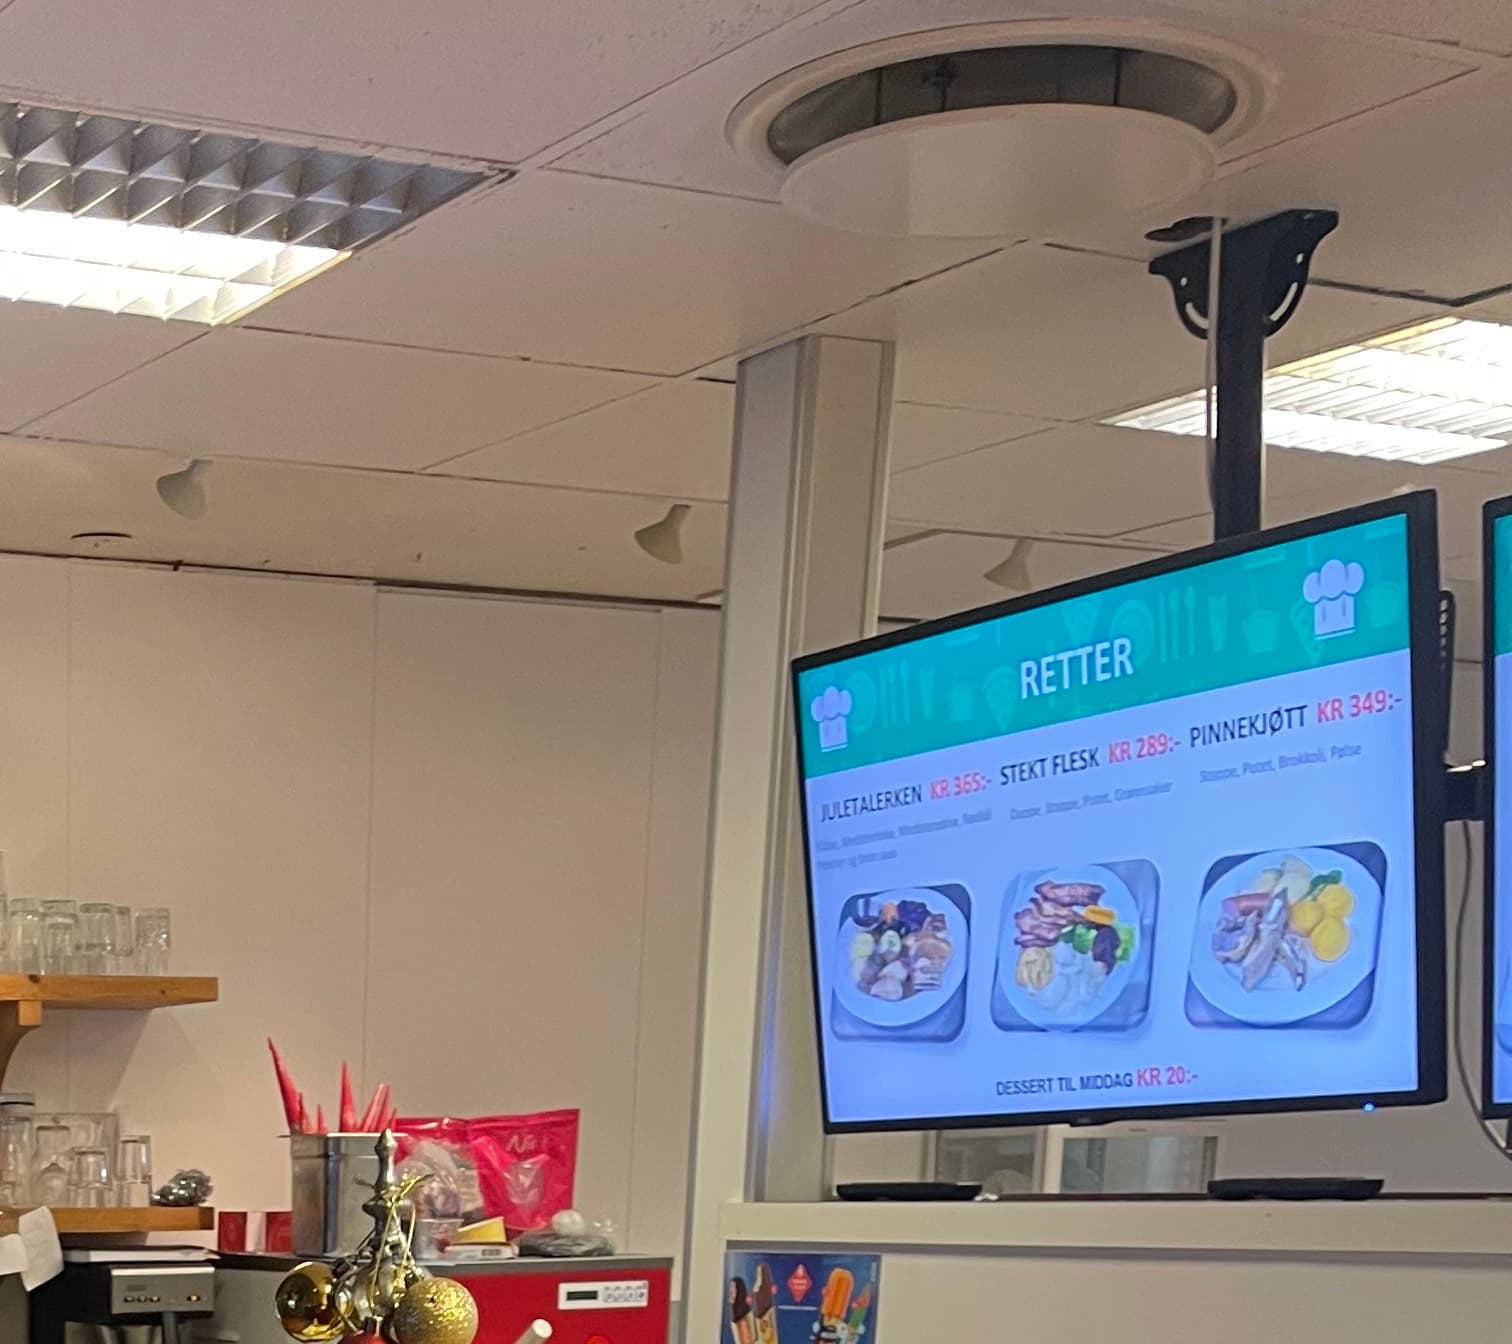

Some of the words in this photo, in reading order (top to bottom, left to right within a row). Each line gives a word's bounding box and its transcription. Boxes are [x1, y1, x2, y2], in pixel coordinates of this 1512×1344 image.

[1020, 637, 1134, 699] RETTER
[1190, 705, 1308, 748] PINNEKJØTT
[1317, 698, 1344, 723] KR
[1349, 689, 1403, 718] 349:-
[1000, 757, 1048, 786] STEKT
[1052, 748, 1100, 776] FLESK
[1107, 742, 1131, 764] KR
[1135, 732, 1181, 759] 289:-
[820, 784, 923, 823] JULETALERKEN
[929, 778, 950, 800] KR
[953, 772, 992, 798] 365:-
[996, 1077, 1052, 1096] DESSERT
[1058, 1077, 1077, 1092] TIL
[1080, 1073, 1133, 1090] MIDDAG
[1137, 1068, 1161, 1087] KR
[1167, 1066, 1199, 1086] 20:-
